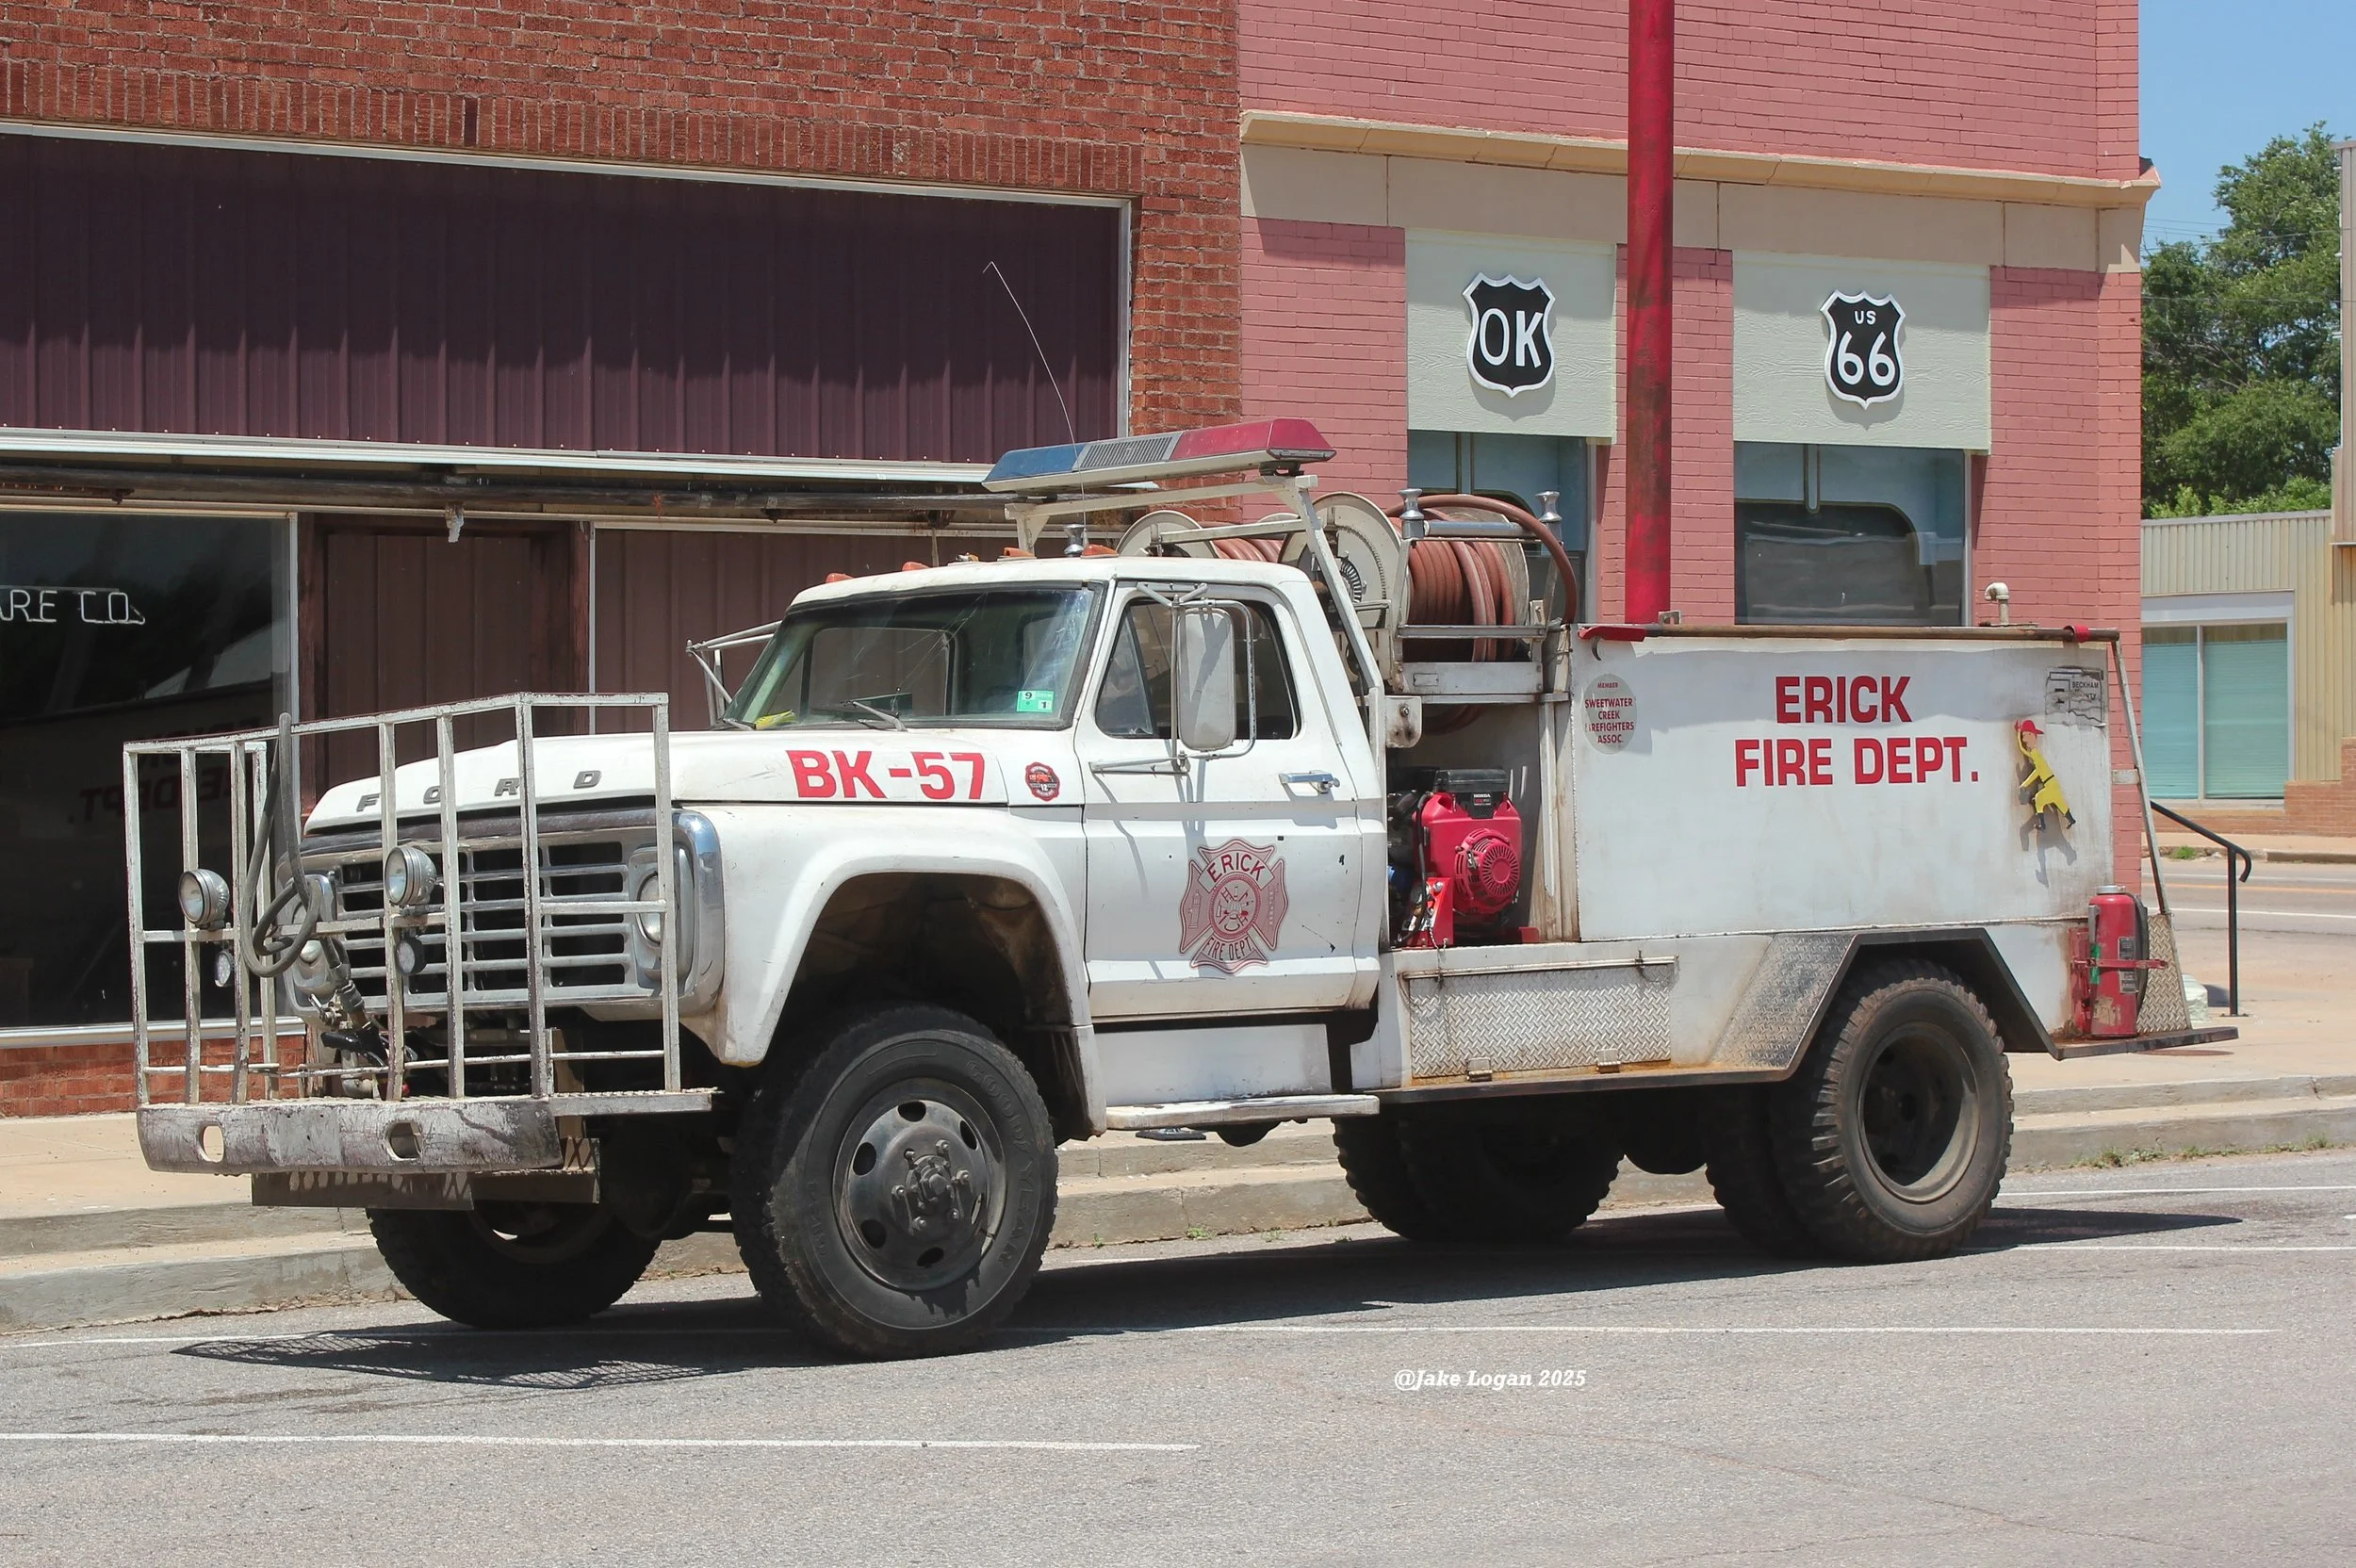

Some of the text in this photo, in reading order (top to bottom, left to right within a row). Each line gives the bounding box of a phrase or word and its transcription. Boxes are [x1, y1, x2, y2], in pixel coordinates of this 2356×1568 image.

[1854, 310, 1876, 325] US
[1479, 307, 1544, 368] OK
[1837, 330, 1896, 386] 66
[1024, 692, 1033, 700] 9
[1584, 697, 1633, 709] SWEETWATER
[1775, 675, 1912, 724] ERICK
[1597, 710, 1621, 720] CREEK
[785, 750, 985, 800] BK-57
[1735, 736, 1978, 787] FIRE DEPT.
[356, 770, 602, 812] FORD
[1207, 852, 1265, 883] ERICK
[1202, 937, 1254, 961] FIRE DEPT.
